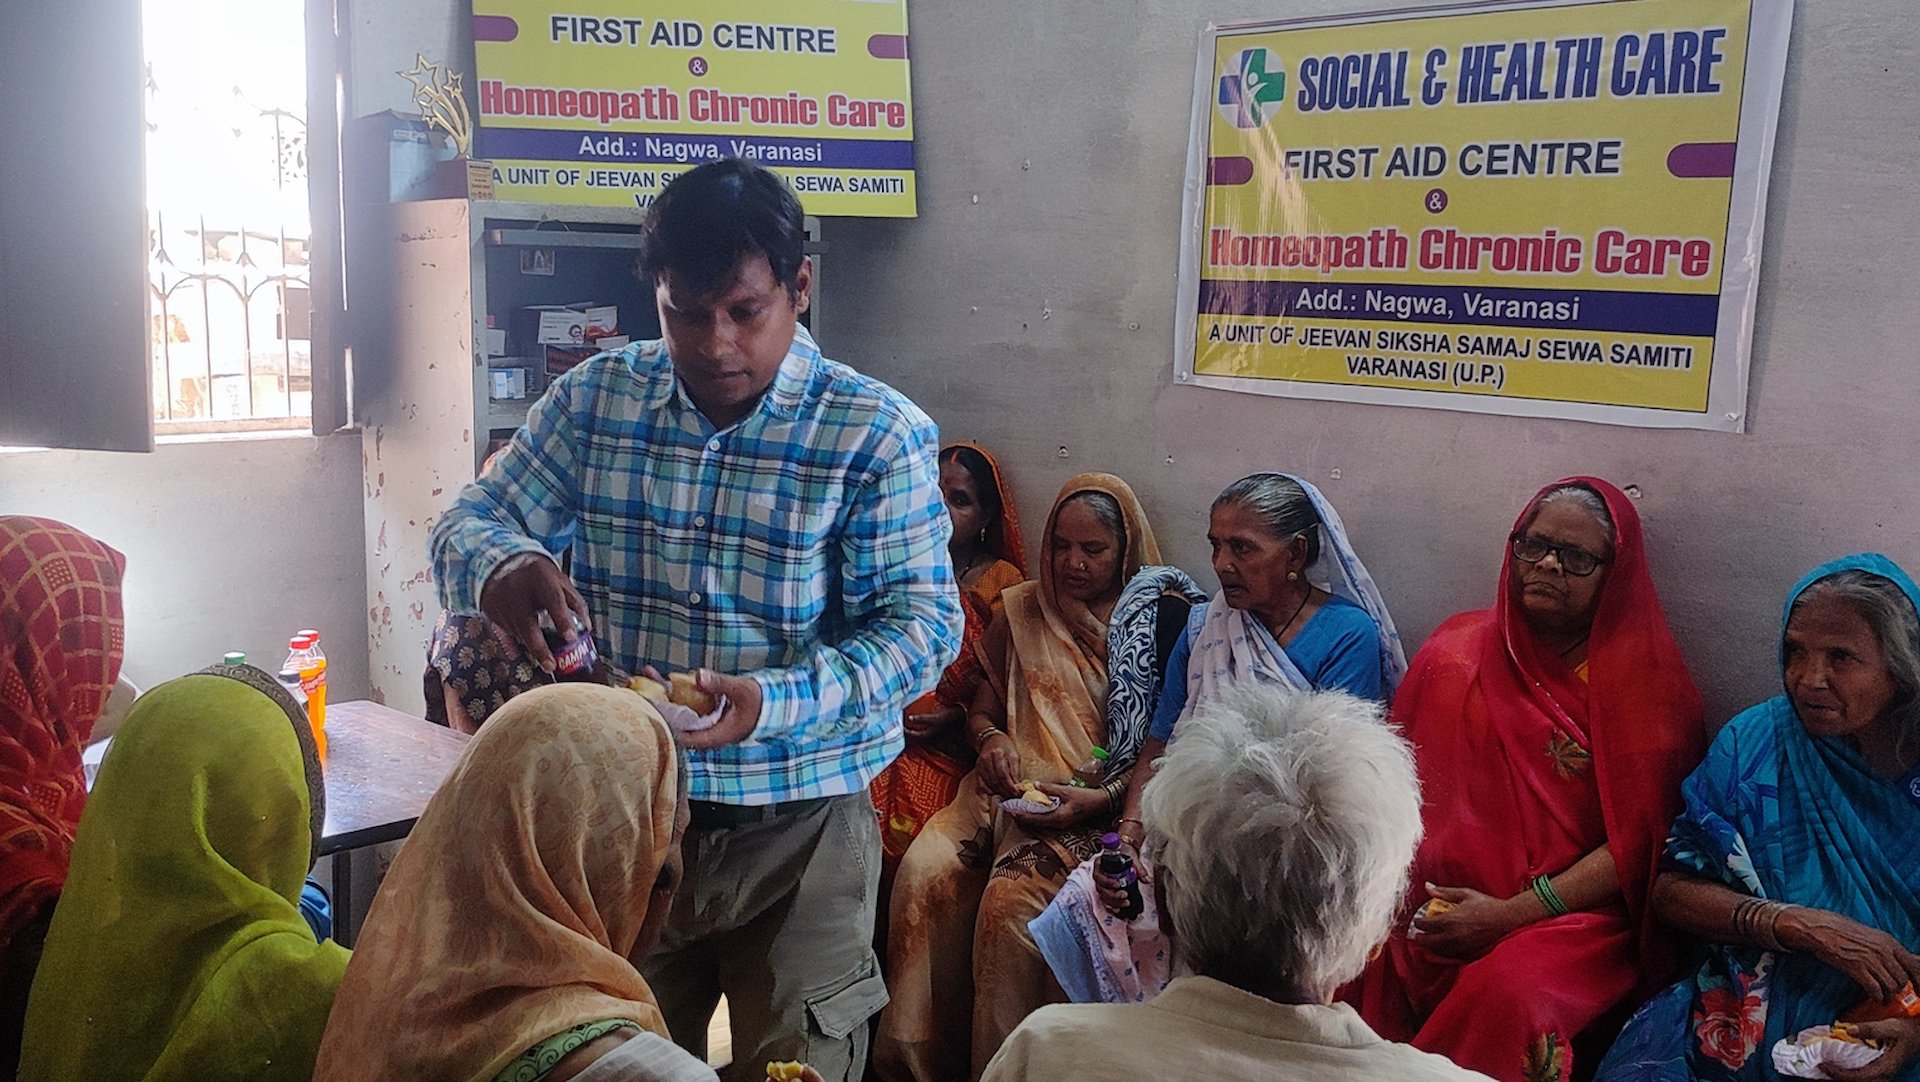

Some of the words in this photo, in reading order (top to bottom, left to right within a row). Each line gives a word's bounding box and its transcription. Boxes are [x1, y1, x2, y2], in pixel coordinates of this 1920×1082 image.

[551, 16, 641, 46] FIRST
[651, 22, 702, 48] AID
[714, 24, 836, 53] CENTRE
[692, 59, 704, 74] &
[1298, 52, 1410, 112] SOCIAL
[1423, 48, 1447, 106] &
[1457, 37, 1603, 103] HEALTH
[1610, 28, 1726, 97] CARE
[480, 80, 678, 123] Homeopath
[689, 89, 817, 126] Chronic
[828, 95, 905, 128] Care
[579, 136, 638, 157] Add.:
[731, 140, 822, 162] Varanasi
[1284, 147, 1379, 181] FIRST
[1385, 144, 1447, 177] AID
[1458, 141, 1621, 176] CENTRE
[492, 168, 503, 184] A
[508, 168, 550, 185] UNIT
[556, 170, 580, 185] OF
[586, 171, 655, 188] JEEVAN
[795, 176, 844, 192] SEWA
[849, 178, 904, 193] SAMITI
[1429, 192, 1443, 210] &
[1210, 228, 1407, 274] Homeopath
[1419, 229, 1581, 273] Chronic
[1594, 230, 1710, 277] Care
[1296, 288, 1356, 311] Add.:
[1365, 289, 1453, 319] Nagwa,
[1463, 293, 1580, 320] Varanasi
[1209, 325, 1220, 341] A
[1226, 325, 1264, 343] UNIT
[1270, 326, 1294, 344] OF
[1299, 328, 1371, 349] JEEVAN
[1377, 332, 1451, 353] SIKSHA
[1457, 335, 1531, 358] SAMAJ
[1538, 340, 1603, 362] SEWA
[1610, 344, 1692, 368] SAMITI
[1347, 356, 1447, 381] VARANASI
[1453, 363, 1505, 390] (U.P.)
